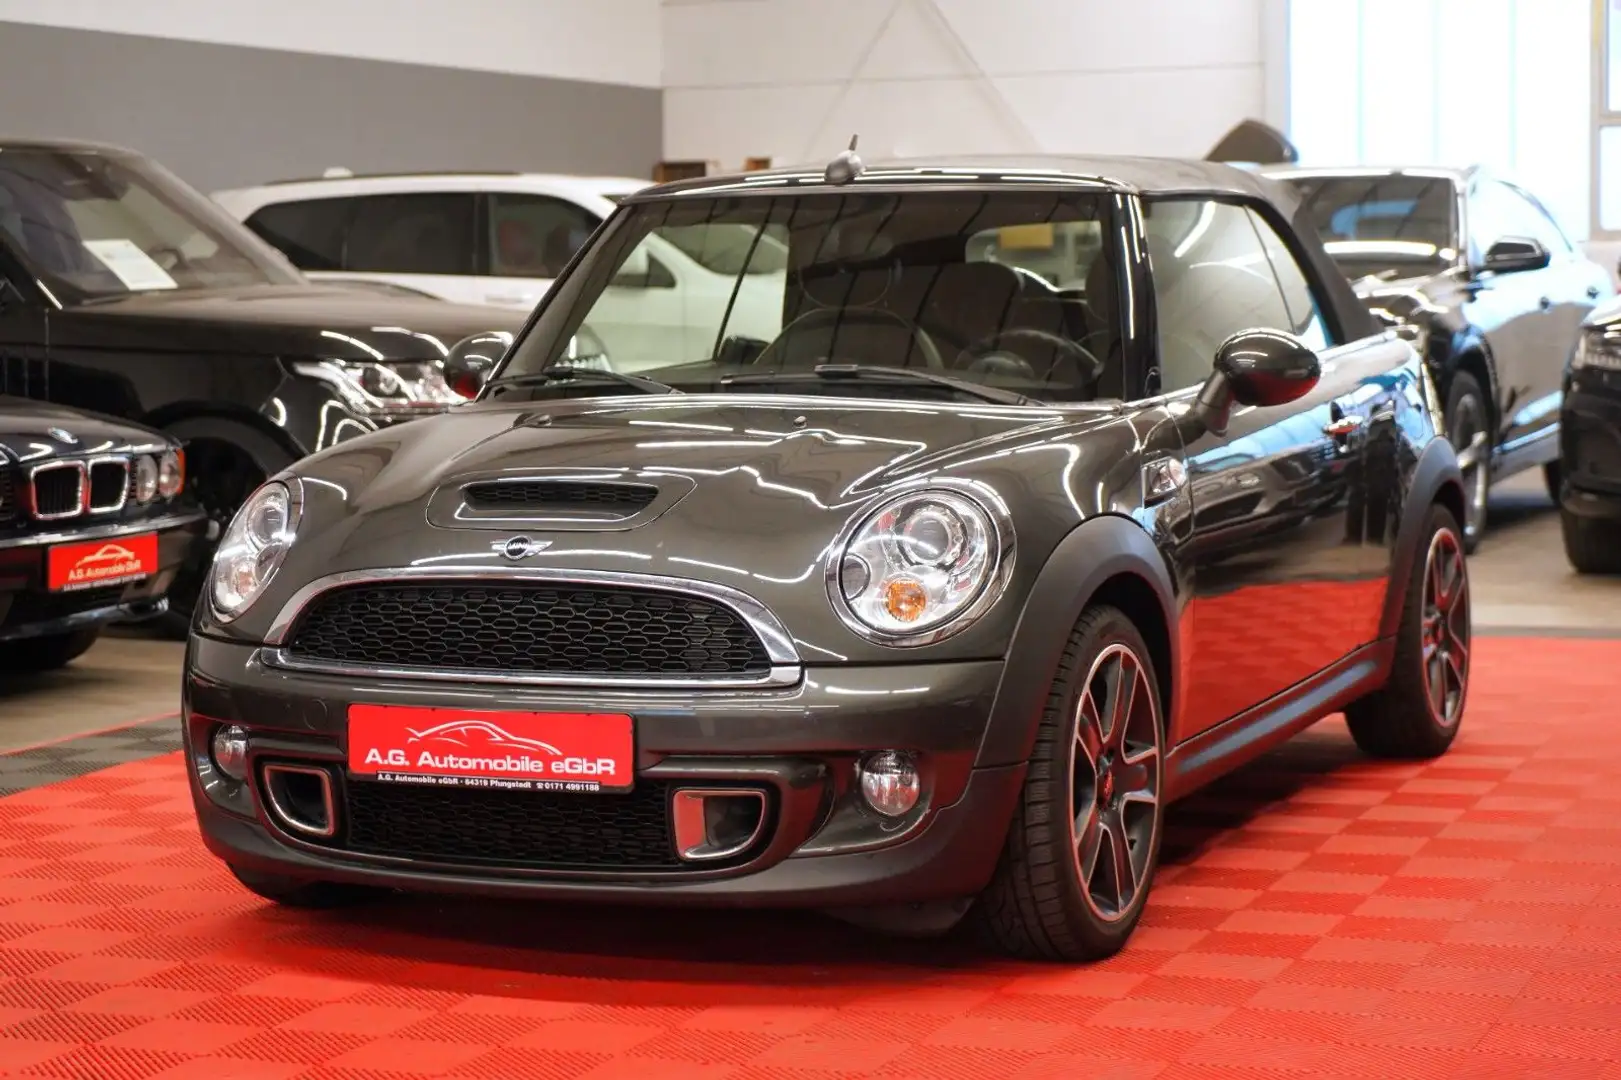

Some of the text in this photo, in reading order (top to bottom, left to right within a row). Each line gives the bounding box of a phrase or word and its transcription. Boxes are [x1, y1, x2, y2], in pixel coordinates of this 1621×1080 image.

[365, 748, 616, 775] A.G. Automobile eGbR
[377, 773, 393, 781] A.G.
[395, 774, 436, 784] Automobile
[438, 777, 458, 785] eGbR
[490, 779, 532, 789] Pfungstadt
